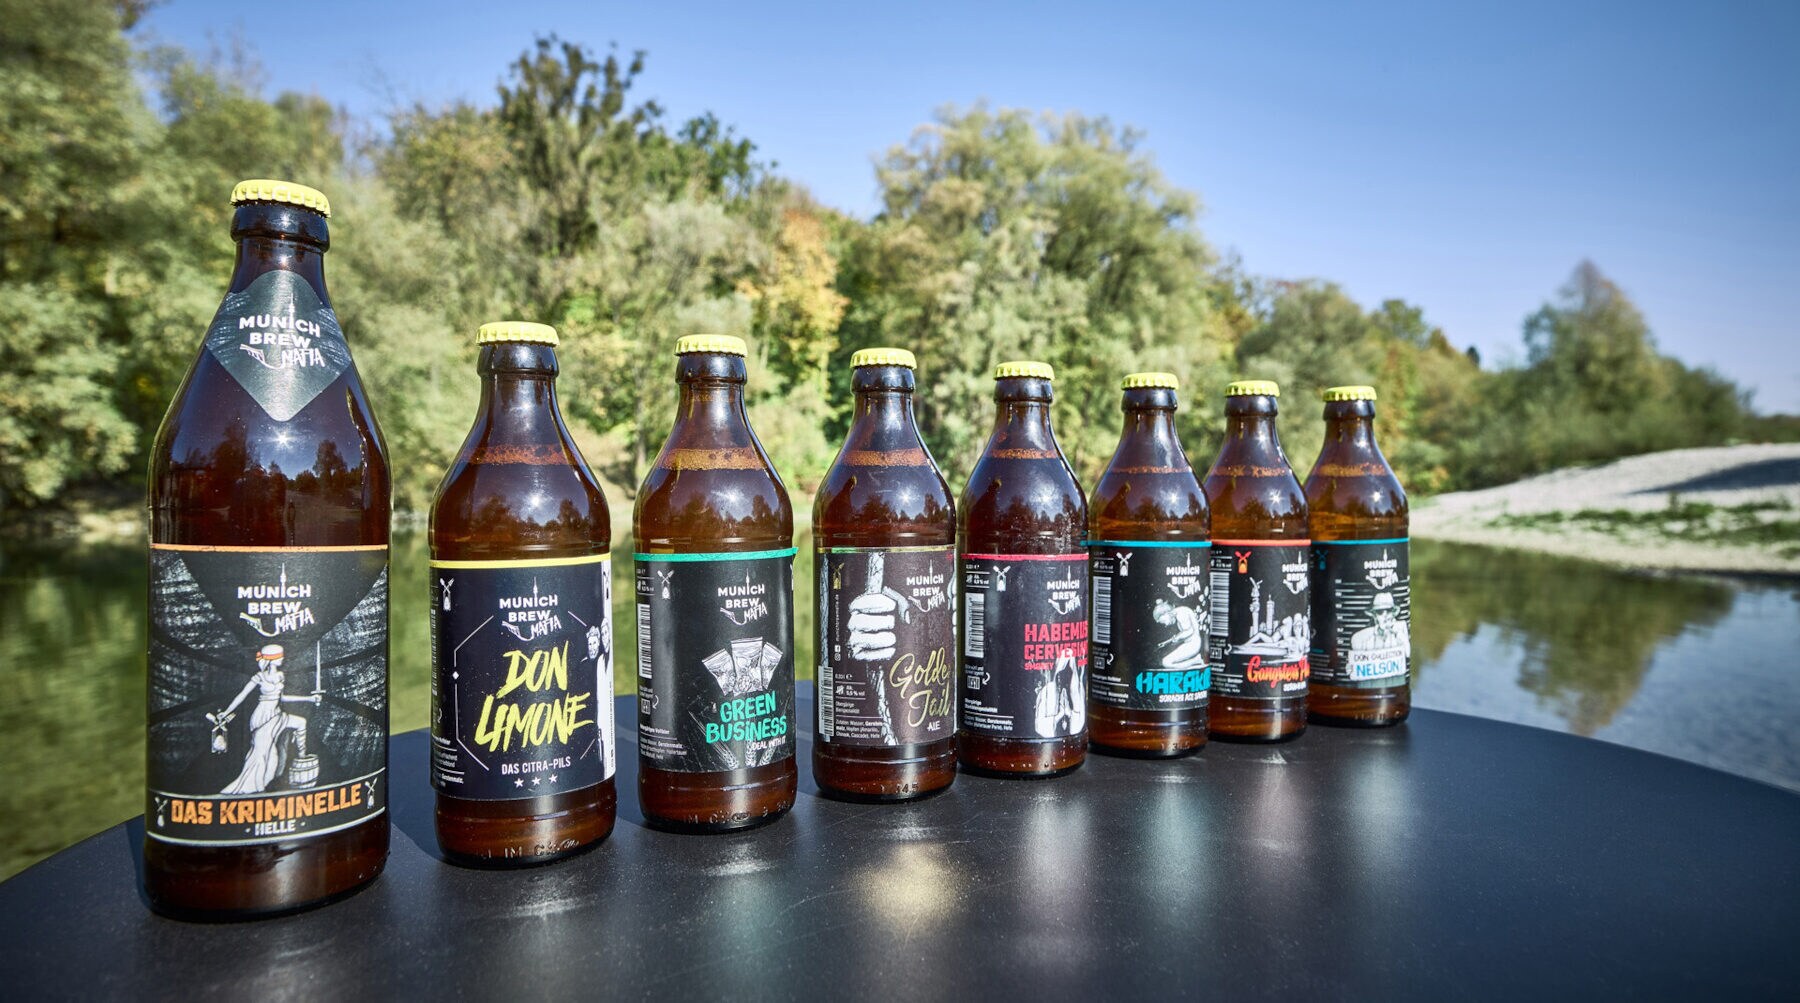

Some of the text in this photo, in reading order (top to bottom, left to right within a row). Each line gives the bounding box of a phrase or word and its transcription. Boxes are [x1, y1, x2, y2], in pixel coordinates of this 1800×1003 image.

[239, 308, 321, 337] MUNICH
[250, 332, 311, 349] BREW
[281, 347, 325, 367] MAFIA
[1166, 561, 1200, 575] MUNICH
[1282, 558, 1308, 573] MUNICH
[1364, 556, 1397, 569] MUNICH
[906, 569, 944, 585] MUNICH
[1047, 575, 1080, 590] MUNICH
[1171, 576, 1197, 585] BREW
[238, 578, 311, 599] MUNICH
[718, 578, 765, 597] MUNICH
[912, 587, 941, 597] BREW
[1052, 591, 1077, 600] BREW
[247, 601, 302, 615] BREW
[499, 589, 558, 609] MUNICH
[725, 597, 760, 609] BREW
[928, 591, 945, 609] MAFIA
[275, 607, 315, 633] MAFIA
[508, 610, 551, 623] BREW
[744, 602, 768, 621] MAFIA
[530, 615, 562, 637] MAFIA
[496, 640, 569, 699] DON
[1356, 660, 1400, 677] NELSON
[720, 691, 776, 723] GREEN
[474, 692, 594, 752] LIMONE
[706, 715, 787, 744] BUSINESS
[501, 756, 571, 775] DAS CITRA-PILS
[171, 783, 362, 825] DAS KRIMINELLE
[254, 819, 296, 836] HELLE
